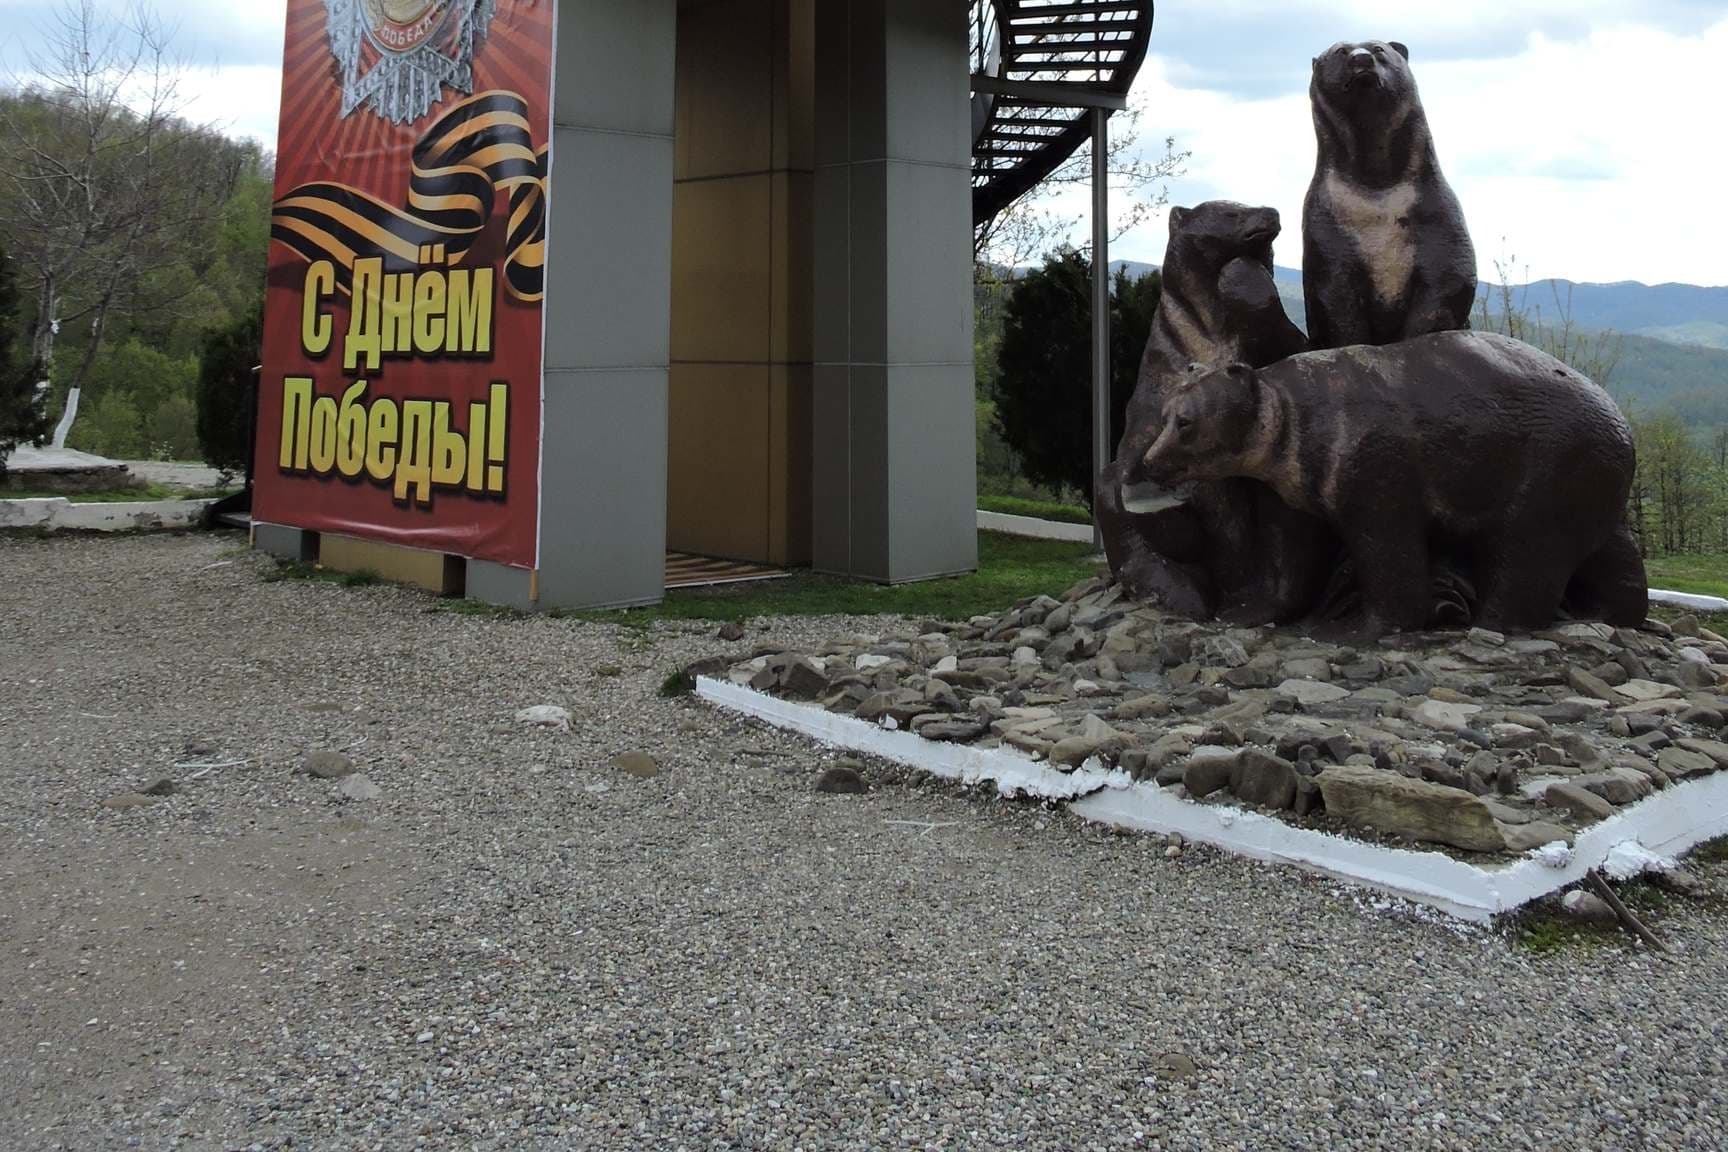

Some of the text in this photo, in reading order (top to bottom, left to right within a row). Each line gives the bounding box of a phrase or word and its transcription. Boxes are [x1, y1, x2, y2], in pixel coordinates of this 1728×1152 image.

[380, 15, 433, 46] ПОБЕДА
[301, 243, 495, 370] С Днём
[279, 377, 508, 504] Победы!
